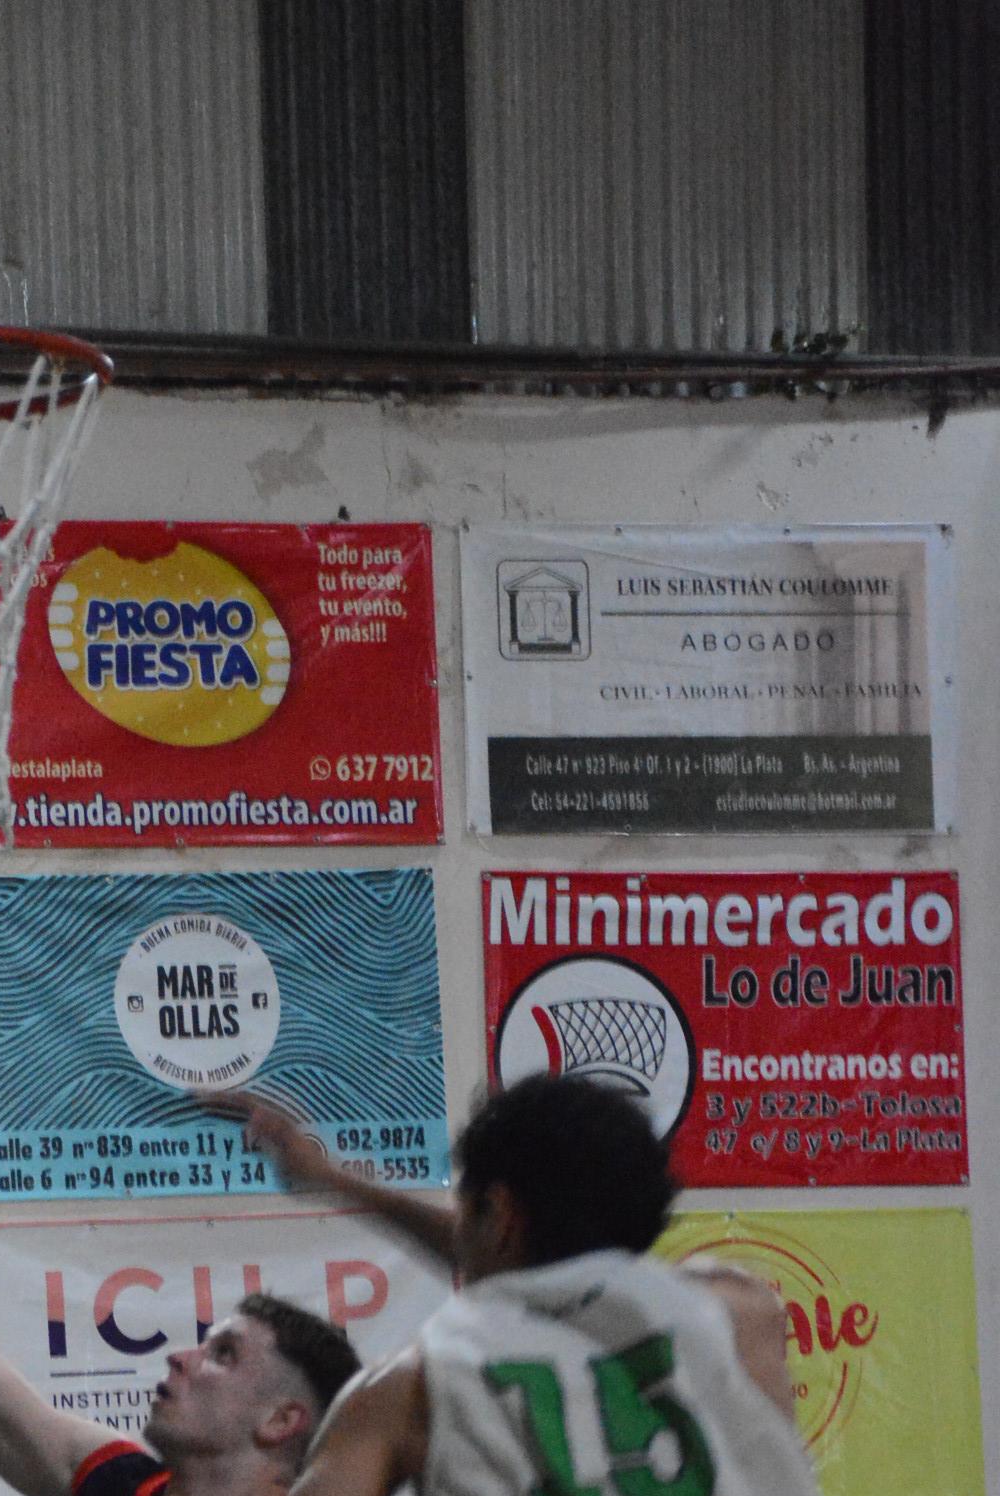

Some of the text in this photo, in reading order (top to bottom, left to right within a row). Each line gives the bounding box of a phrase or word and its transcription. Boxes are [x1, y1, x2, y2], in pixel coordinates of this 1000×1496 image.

[318, 543, 402, 570] Todo para
[318, 570, 407, 594] tu freezer,
[617, 578, 661, 596] LUIS
[779, 578, 892, 597] COULOMME
[85, 599, 257, 642] PROMO
[319, 598, 407, 619] tu evento,
[321, 621, 387, 648] y más!!!
[681, 631, 836, 651] ABOGADO
[86, 641, 260, 690] FIESTA
[600, 686, 650, 700] CIVIL
[383, 755, 434, 782] 7912
[489, 877, 954, 948] Minimercado
[157, 964, 238, 1000] MAR DE
[702, 953, 955, 1008] Lo de Juan
[158, 1003, 241, 1039] OLLAS
[702, 1048, 960, 1082] Encontranos en:
[705, 1092, 725, 1120] 3
[732, 1099, 752, 1126] y
[39, 1136, 64, 1159] 39
[139, 1136, 191, 1158] entre
[196, 1132, 218, 1157] 11
[223, 1137, 234, 1162] y
[336, 1125, 427, 1152] 692-9874
[705, 1127, 738, 1155] 47
[783, 1127, 800, 1153] 8
[805, 1131, 824, 1159] y
[895, 1126, 962, 1151] Plata
[40, 1168, 53, 1192] 6
[123, 1168, 182, 1190] entre
[188, 1163, 214, 1186] 33
[221, 1168, 232, 1193] y
[240, 1161, 267, 1186] 34
[52, 1390, 158, 1411] INSTITUT
